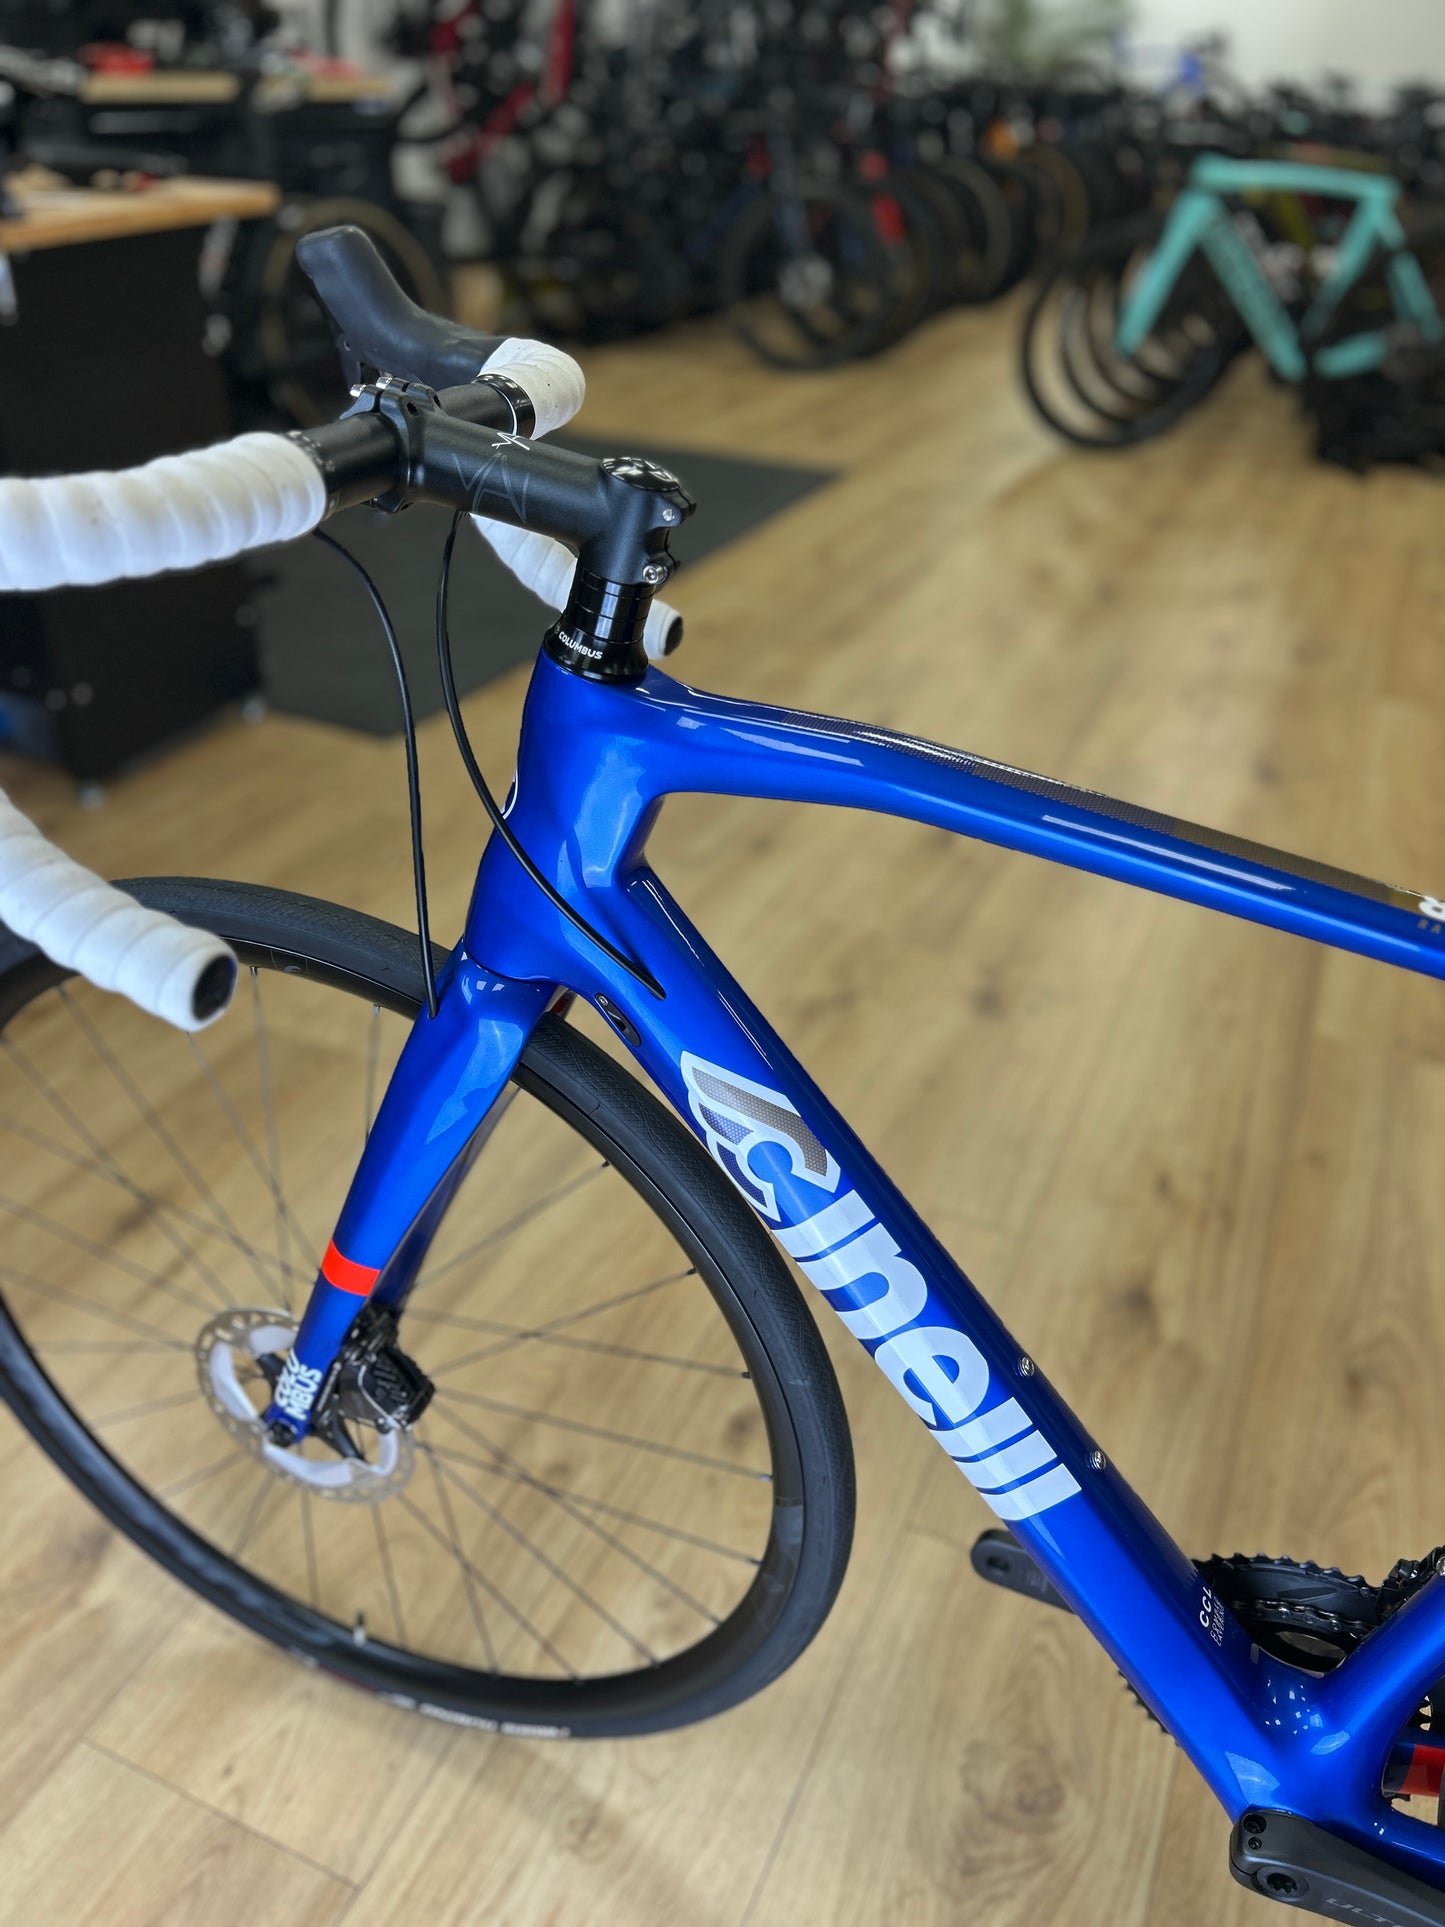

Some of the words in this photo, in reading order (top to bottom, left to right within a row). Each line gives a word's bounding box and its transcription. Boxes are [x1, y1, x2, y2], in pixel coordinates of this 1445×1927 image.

[558, 631, 603, 660] COLUMBUS
[284, 1364, 322, 1420] MBUS
[1199, 1586, 1212, 1628] CCL
[1326, 1898, 1404, 1927] ULT
